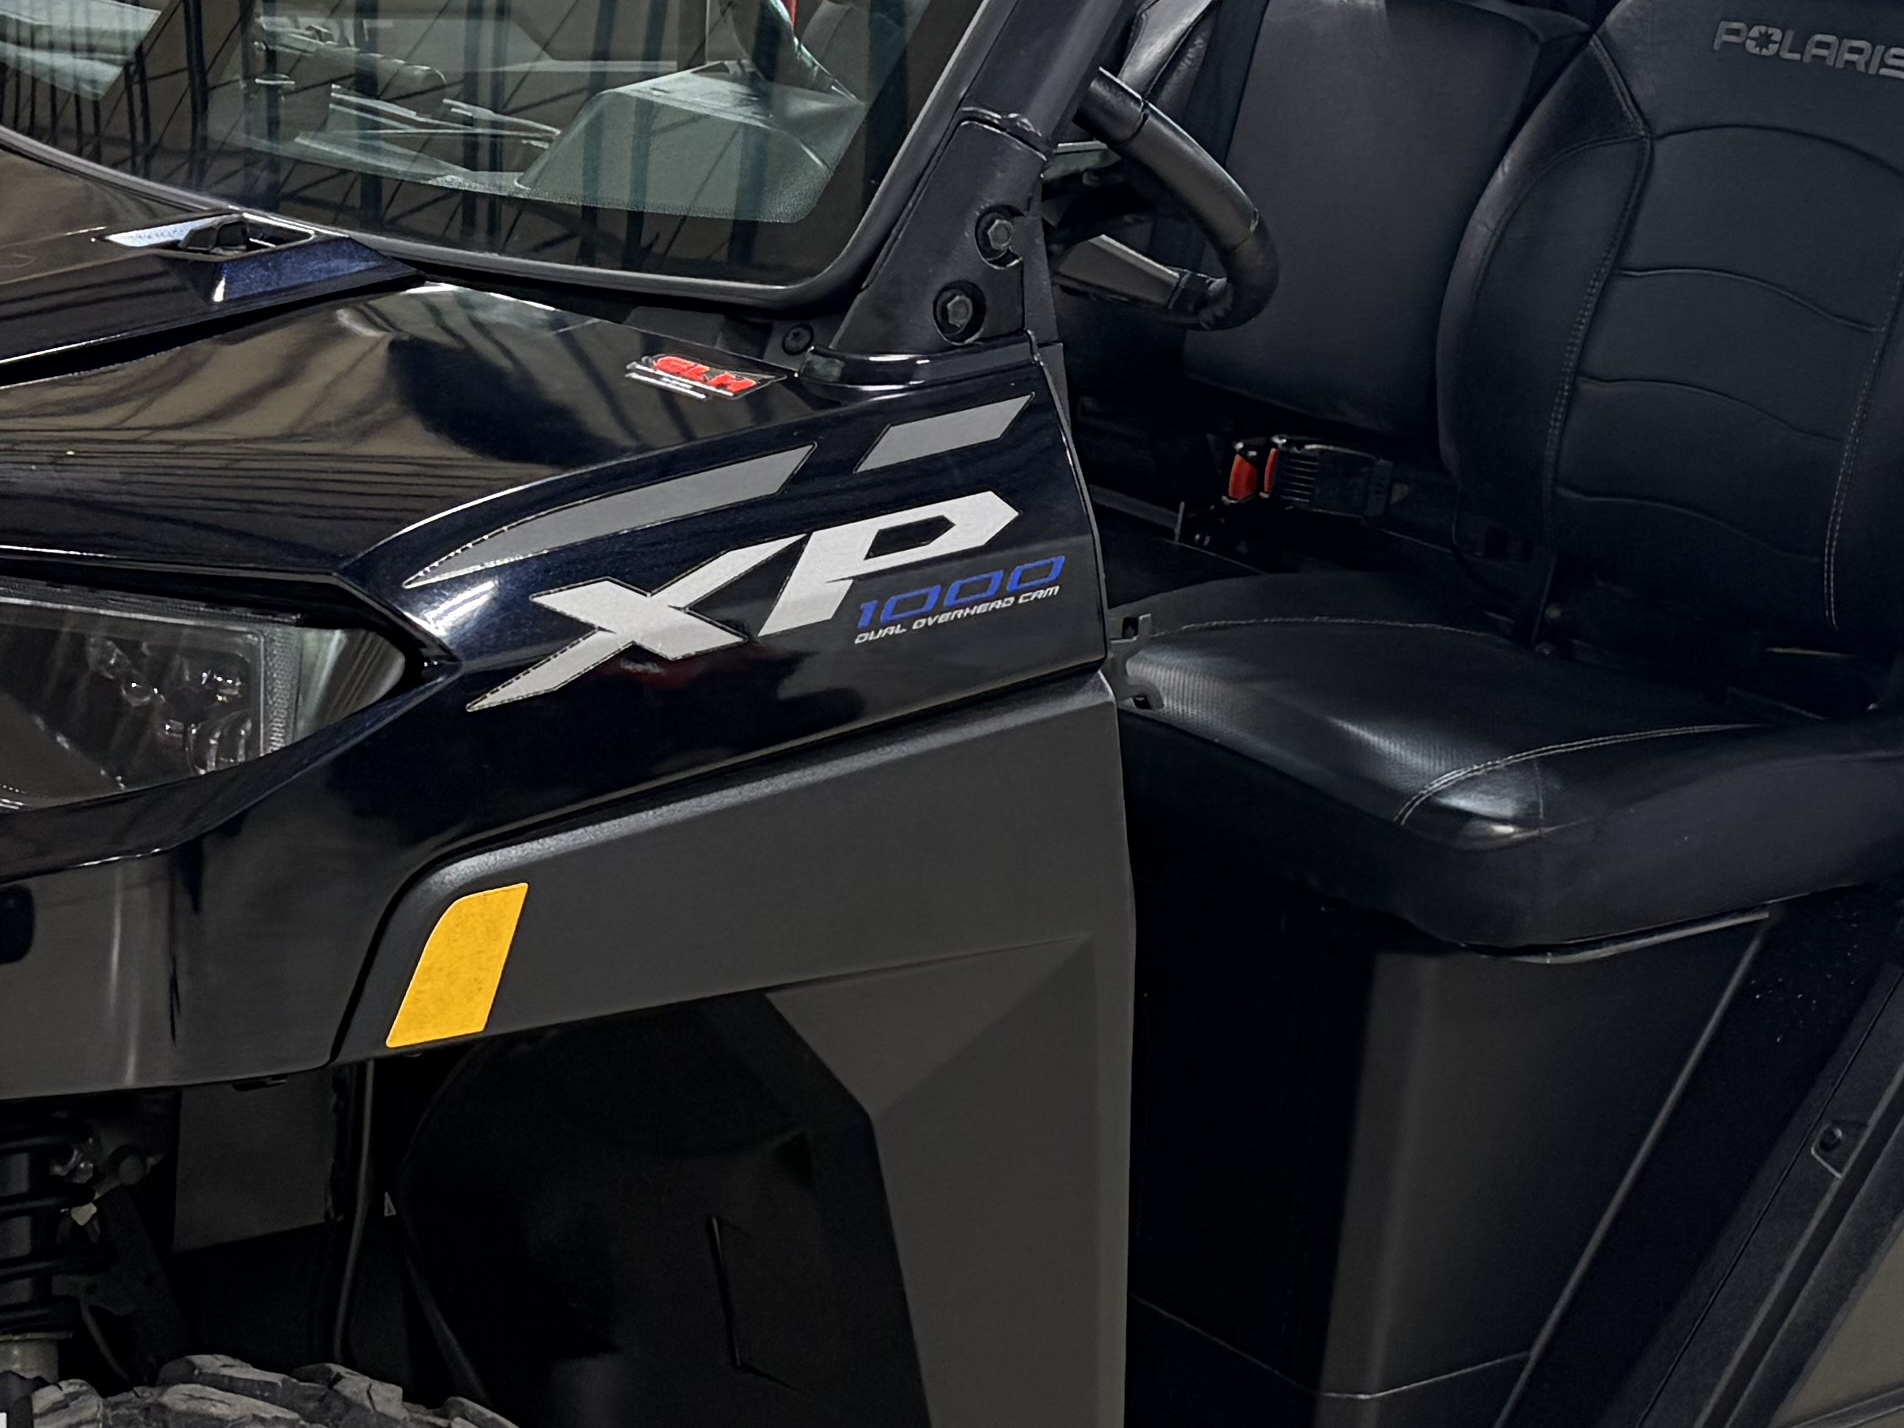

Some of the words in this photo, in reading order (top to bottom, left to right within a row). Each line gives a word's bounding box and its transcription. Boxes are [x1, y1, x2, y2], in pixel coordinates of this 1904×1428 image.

[467, 490, 1020, 712] XP
[854, 623, 907, 644] DUAL
[912, 596, 1015, 630] OVERHEAD
[1018, 585, 1060, 604] CAM
[857, 555, 1066, 630] 1000
